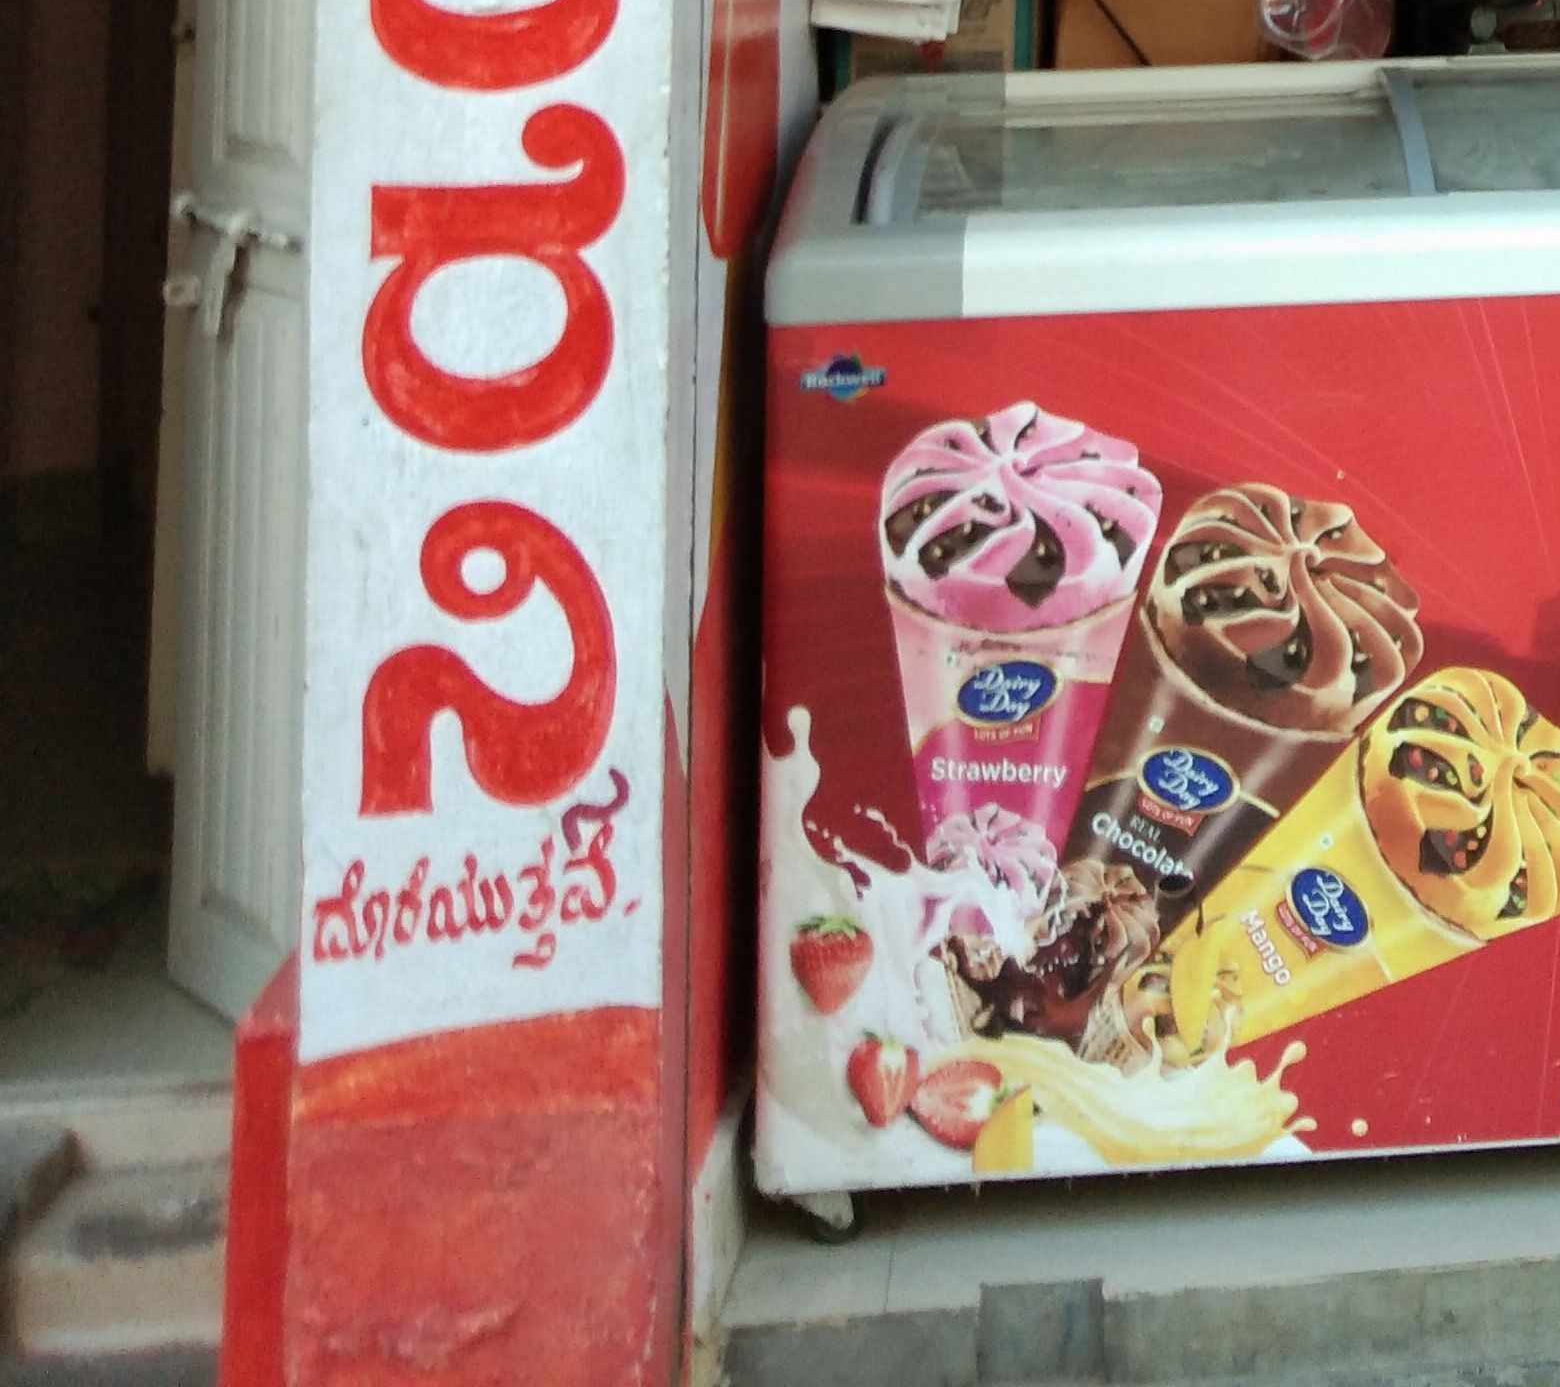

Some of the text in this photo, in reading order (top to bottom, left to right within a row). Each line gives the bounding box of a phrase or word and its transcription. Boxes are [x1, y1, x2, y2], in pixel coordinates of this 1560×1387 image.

[973, 664, 1042, 701] Dairy
[979, 689, 1031, 722] Day
[931, 756, 1067, 788] Strawberry
[1241, 908, 1291, 986] Mango
